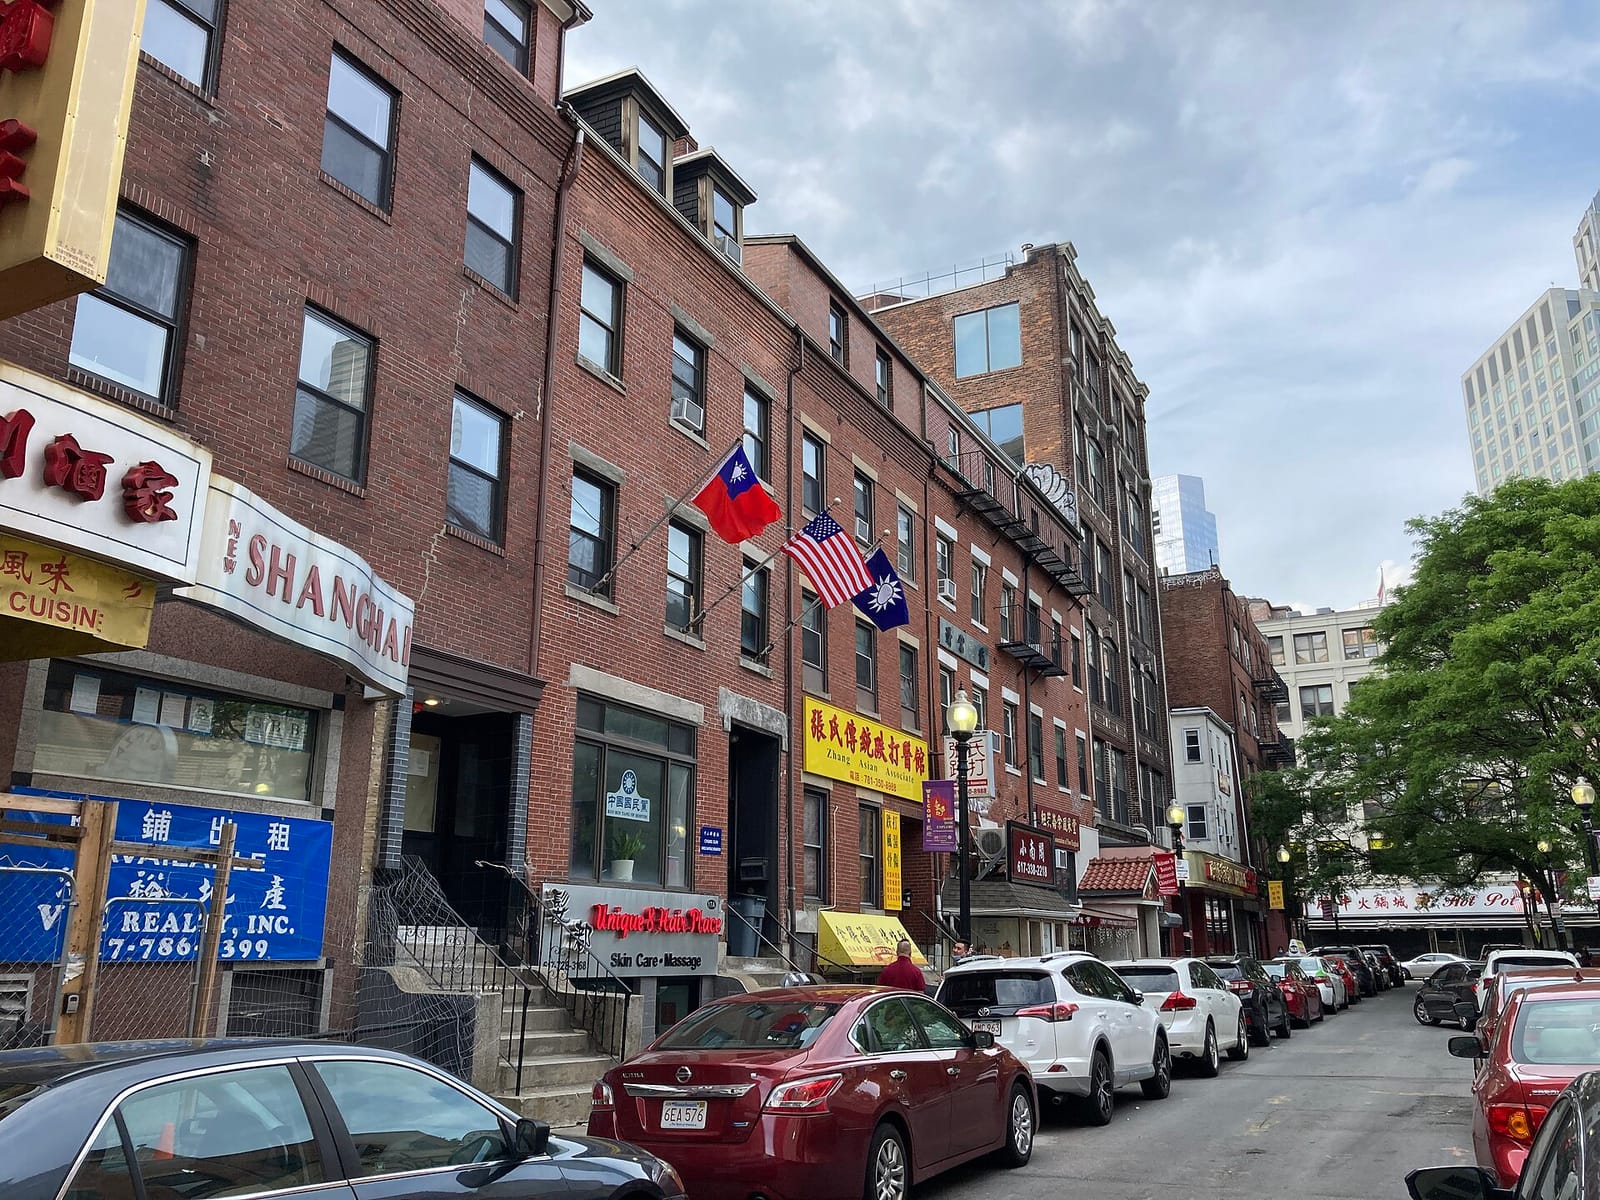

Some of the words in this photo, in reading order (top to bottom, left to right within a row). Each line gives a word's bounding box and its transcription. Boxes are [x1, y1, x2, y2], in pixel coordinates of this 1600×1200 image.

[224, 519, 242, 575] NEW
[0, 550, 75, 594] 風味
[246, 534, 412, 667] SHANGHAI
[826, 747, 851, 765] Zhang
[859, 759, 878, 773] Asian
[885, 768, 914, 784] Associate
[608, 795, 649, 812] 中國國民黨
[1443, 896, 1476, 908] Hot
[1484, 892, 1517, 907] Pot
[247, 915, 295, 935] INC.
[593, 904, 645, 939] Unique
[659, 907, 687, 934] Hair
[687, 908, 721, 934] Place
[610, 953, 633, 968] Skin
[636, 953, 659, 968] Care
[664, 953, 702, 970] Massage
[664, 1108, 682, 1122] 6EA
[685, 1108, 704, 1122] 576
